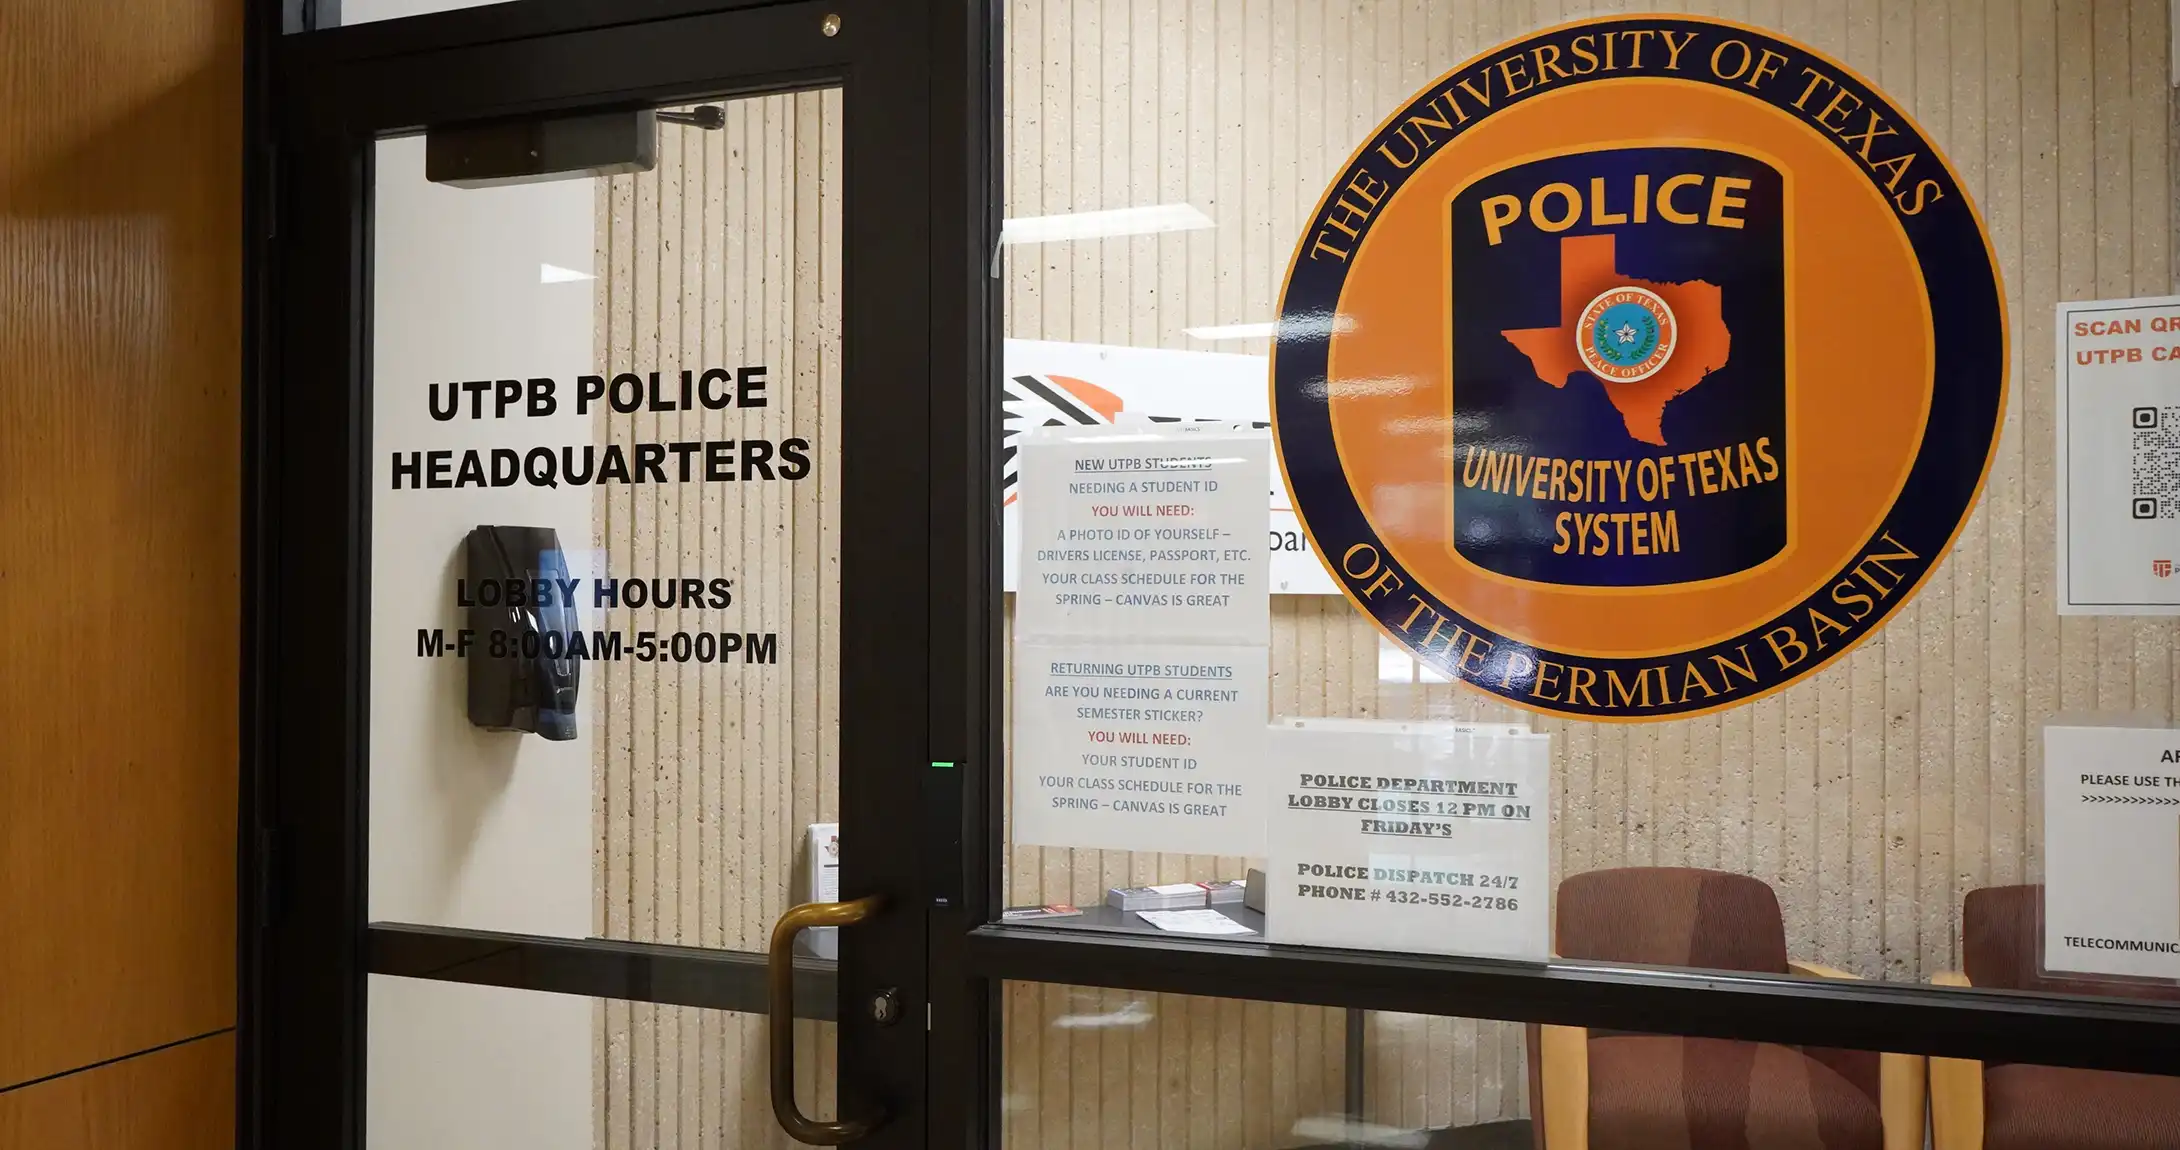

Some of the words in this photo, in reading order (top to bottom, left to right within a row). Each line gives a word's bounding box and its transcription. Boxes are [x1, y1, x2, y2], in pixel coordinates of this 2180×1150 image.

[1309, 168, 1390, 265] THE
[1378, 30, 1700, 168] UNIVERSITY
[1709, 39, 1789, 90] OF
[1797, 66, 1945, 219] TEXAS
[1480, 173, 1752, 246] POLICE
[1585, 297, 1614, 329] STATE
[1616, 293, 1633, 302] OF
[1637, 294, 1669, 326] TEXAS
[2074, 318, 2141, 337] SCAN
[1585, 346, 1617, 376] PEACE
[1621, 343, 1668, 377] OFFICER
[2076, 347, 2142, 365] UTPB
[428, 378, 557, 421] UTPB
[576, 366, 768, 415] POLICE
[392, 437, 811, 489] HEADQUARTERS
[1075, 458, 1104, 471] NEW
[1108, 458, 1142, 470] UTPB
[1145, 457, 1212, 469] STUDENTS
[1462, 445, 1632, 504] UNIVERSITY
[1636, 459, 1677, 500] OF
[1678, 435, 1779, 495] TEXAS
[1069, 482, 1125, 495] NEEDING
[1129, 482, 1138, 493] A
[1141, 481, 1201, 493] STUDENT
[1204, 480, 1218, 492] ID
[1091, 505, 1119, 517] YOU
[1122, 505, 1152, 517] WILL
[1156, 505, 1195, 517] NEED:
[1057, 529, 1066, 541] A
[1070, 529, 1114, 541] PHOTO
[1117, 529, 1130, 541] ID
[1133, 529, 1151, 541] OF
[1154, 528, 1219, 541] YOURSELF
[1553, 510, 1681, 555] SYSTEM
[1037, 550, 1089, 562] DRIVERS
[1093, 550, 1146, 563] LICENSE,
[1150, 550, 1220, 563] PASSPORT,
[1224, 549, 1251, 562] ETC.
[1042, 573, 1077, 585] YOUR
[1080, 573, 1118, 585] CLASS
[1121, 573, 1186, 585] SCHEDULE
[1190, 573, 1216, 585] FOR
[1219, 573, 1245, 585] THE
[457, 578, 581, 608] LOBBY
[594, 578, 732, 609] HOURS
[1055, 593, 1101, 606] SPRING
[1115, 594, 1168, 606] CANVAS
[1172, 594, 1183, 606] IS
[1186, 594, 1230, 607] GREAT
[1340, 541, 1405, 600] OF
[1396, 592, 1497, 678] THE
[1503, 645, 1759, 708] PERMIAN
[1760, 530, 1920, 671] BASIN
[417, 629, 475, 658] M-F
[489, 630, 777, 664] 8:00AM-5:00PM
[1050, 662, 1124, 675] RETURNING
[1127, 664, 1161, 676] UTPB
[1164, 664, 1232, 678] STUDENTS
[1045, 685, 1069, 697] ARE
[1072, 686, 1100, 698] YOU
[1103, 687, 1160, 700] NEEDING
[1163, 689, 1173, 700] A
[1176, 689, 1238, 702] CURRENT
[1077, 707, 1141, 720] SEMESTER
[1144, 709, 1203, 722] STICKER?
[1088, 731, 1115, 743] YOU
[1118, 732, 1149, 744] WILL
[1152, 734, 1191, 746] NEED:
[1082, 754, 1117, 767] YOUR
[1121, 756, 1179, 769] STUDENT
[1183, 758, 1197, 770] ID
[1039, 776, 1074, 788] YOUR
[1077, 777, 1115, 790] CLASS
[1118, 779, 1183, 793] SCHEDULE
[1187, 783, 1213, 795] FOR
[1216, 784, 1242, 796] THE
[1300, 774, 1372, 789] POLICE
[1376, 777, 1518, 796] DEPARTMENT
[2081, 774, 2130, 786] PLEASE
[2134, 776, 2160, 787] USE
[1052, 797, 1098, 810] SPRING
[1113, 800, 1165, 813] CANVAS
[1169, 803, 1180, 815] IS
[1183, 804, 1227, 816] GREAT
[1288, 794, 1353, 811] LOBBY
[1358, 798, 1430, 813] CLOSES
[1437, 802, 1458, 815] 12
[1462, 803, 1496, 817] PM
[1501, 804, 1531, 818] ON
[1361, 819, 1452, 836] FRIDAY'S
[1297, 863, 1369, 880] POLICE
[1373, 868, 1474, 886] DISPATCH
[1479, 875, 1519, 889] 24/7
[1298, 885, 1366, 901] PHONE
[1371, 889, 1381, 901] #
[1386, 890, 1519, 911] 432-552-2786
[2064, 936, 2180, 954] TELECOMMUNIC
